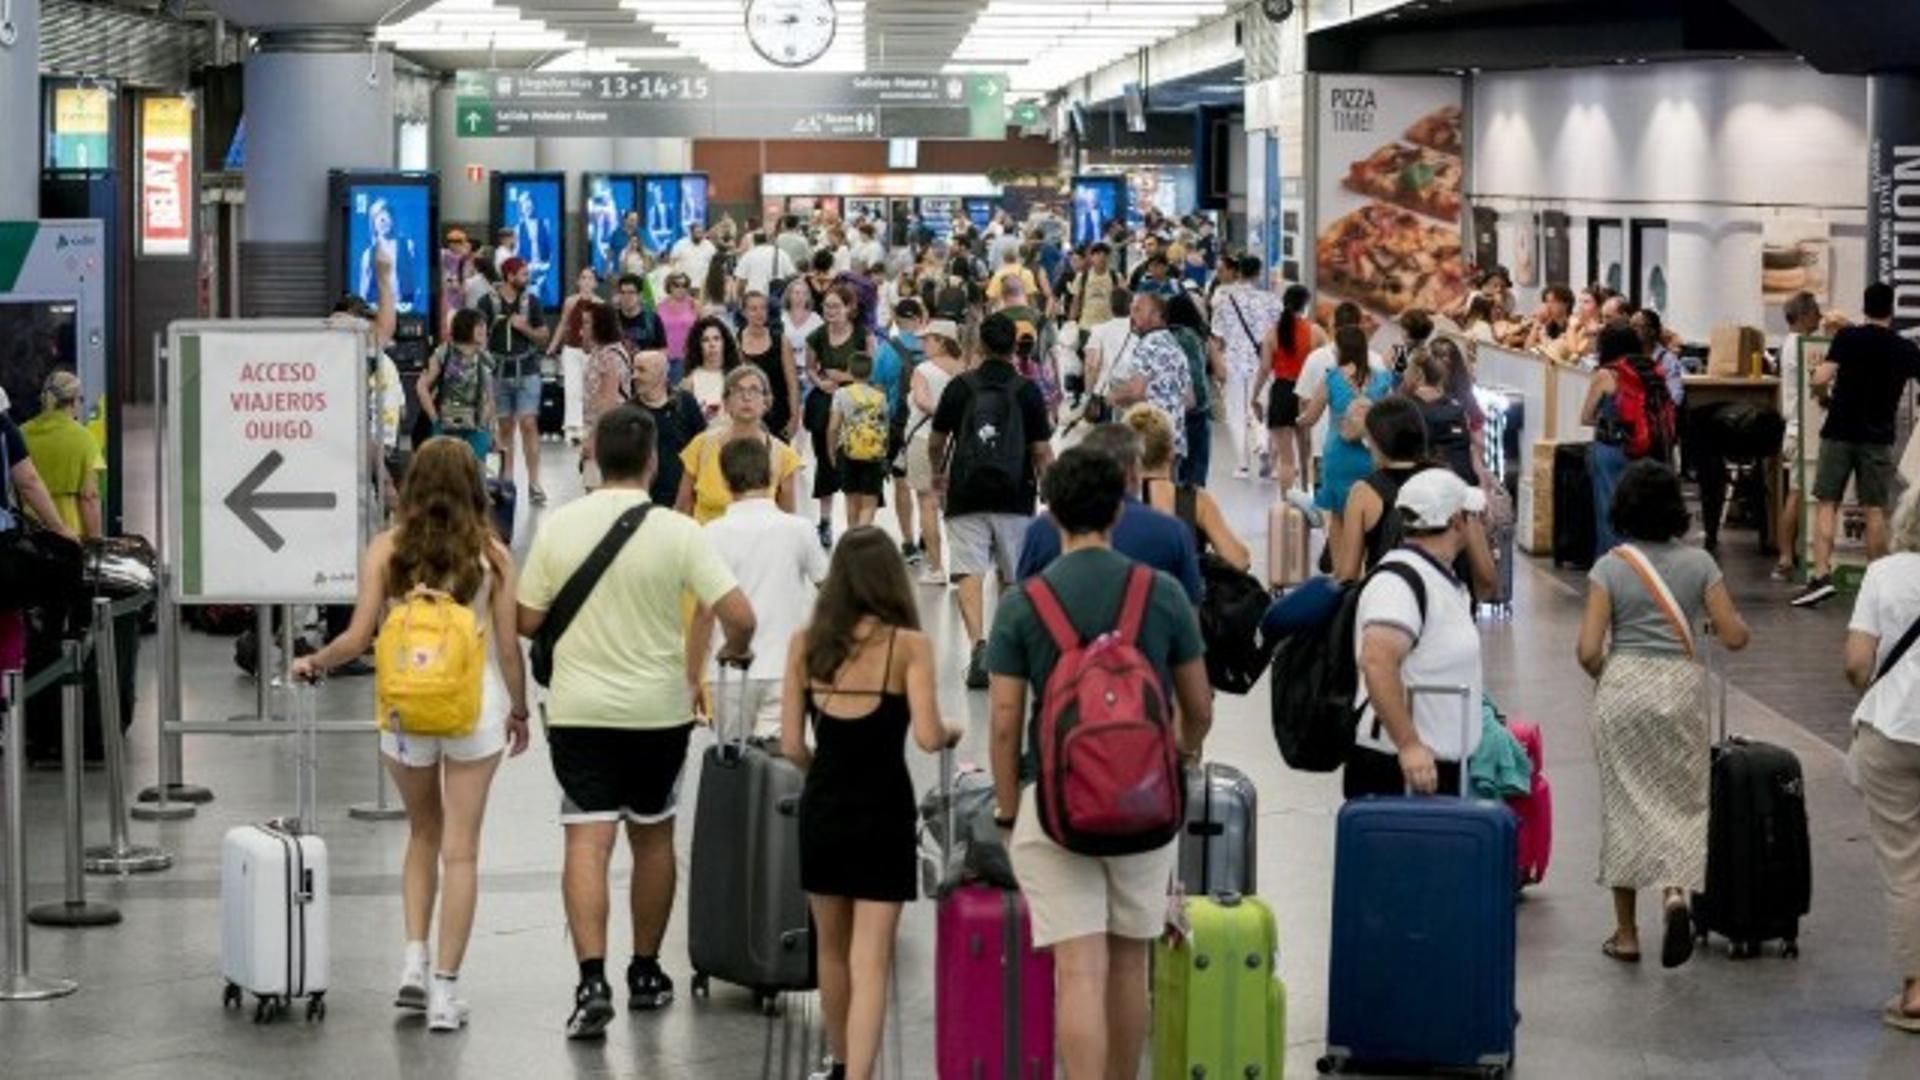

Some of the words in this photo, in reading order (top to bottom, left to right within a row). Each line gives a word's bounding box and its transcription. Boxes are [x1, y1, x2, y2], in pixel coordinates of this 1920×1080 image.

[1331, 88, 1377, 109] PIZZA
[1333, 111, 1374, 133] TIME!
[240, 362, 316, 382] ACCESO
[230, 391, 328, 412] VIAJEROS
[245, 419, 313, 440] OUIGO
